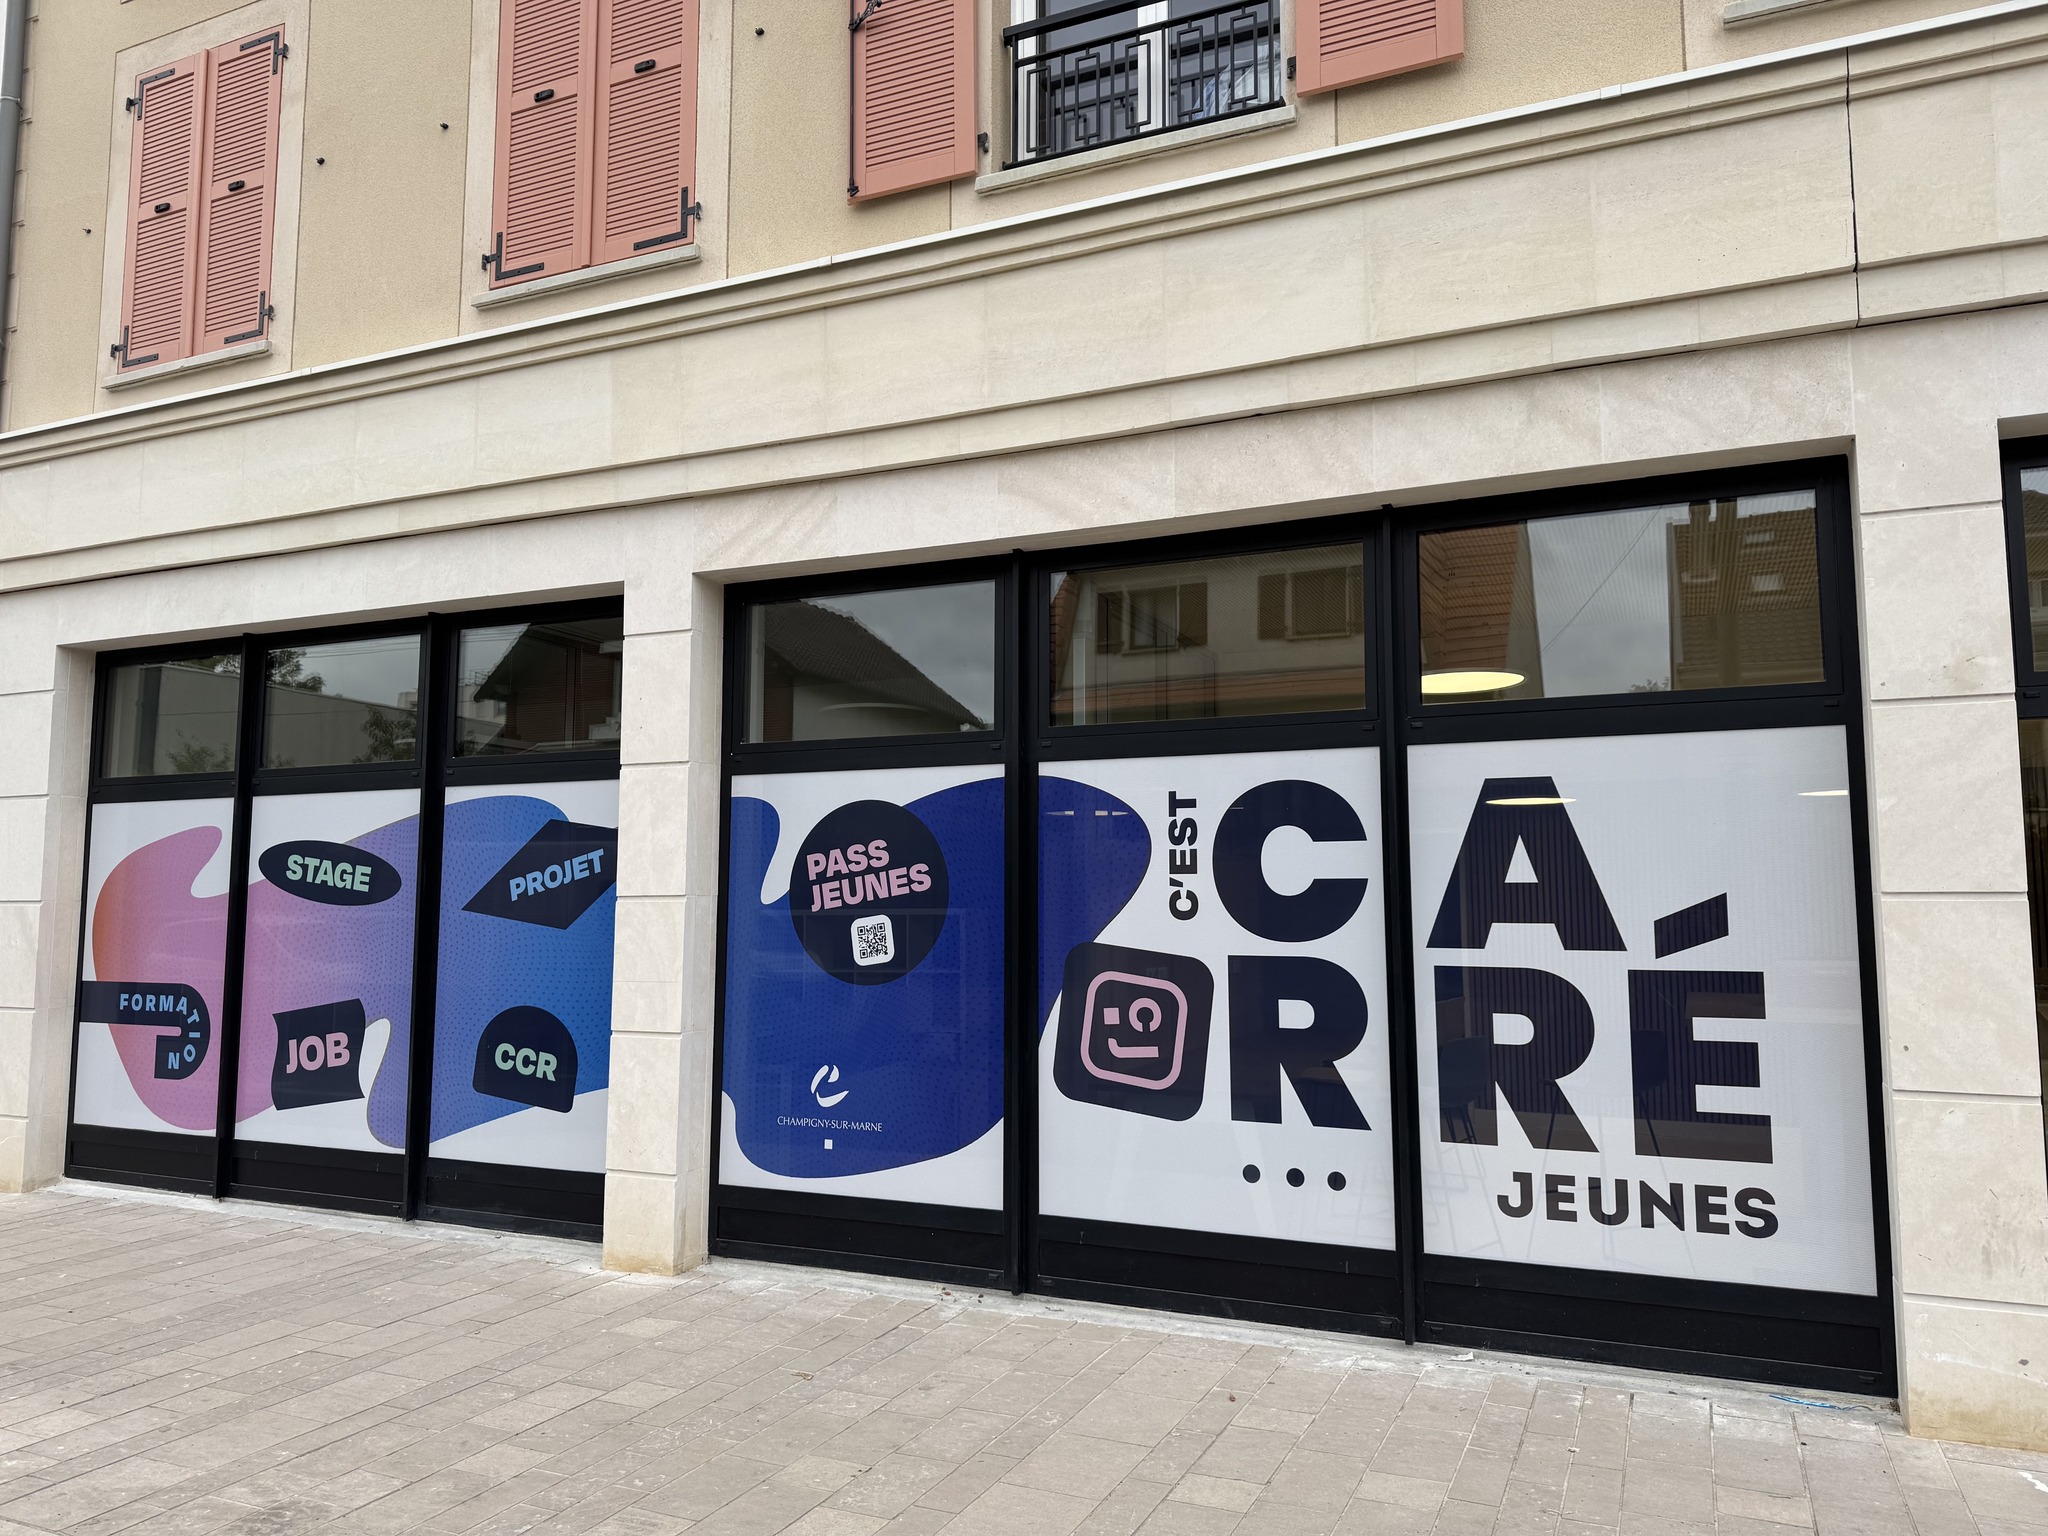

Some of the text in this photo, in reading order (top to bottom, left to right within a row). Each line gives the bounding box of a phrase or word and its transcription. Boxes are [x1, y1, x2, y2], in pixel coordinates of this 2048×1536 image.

[285, 854, 371, 892] STAGE
[509, 848, 604, 901] PROJET
[806, 839, 890, 881] PASS
[1168, 791, 1199, 921] C'EST
[811, 863, 932, 912] JEUNES
[119, 993, 200, 1070] FORMATION
[286, 1031, 350, 1074] JOB
[494, 1042, 558, 1082] CCR
[777, 1116, 883, 1132] CHAMPIGNY-SUR-MARNE
[1496, 1171, 1779, 1239] JEUNES
